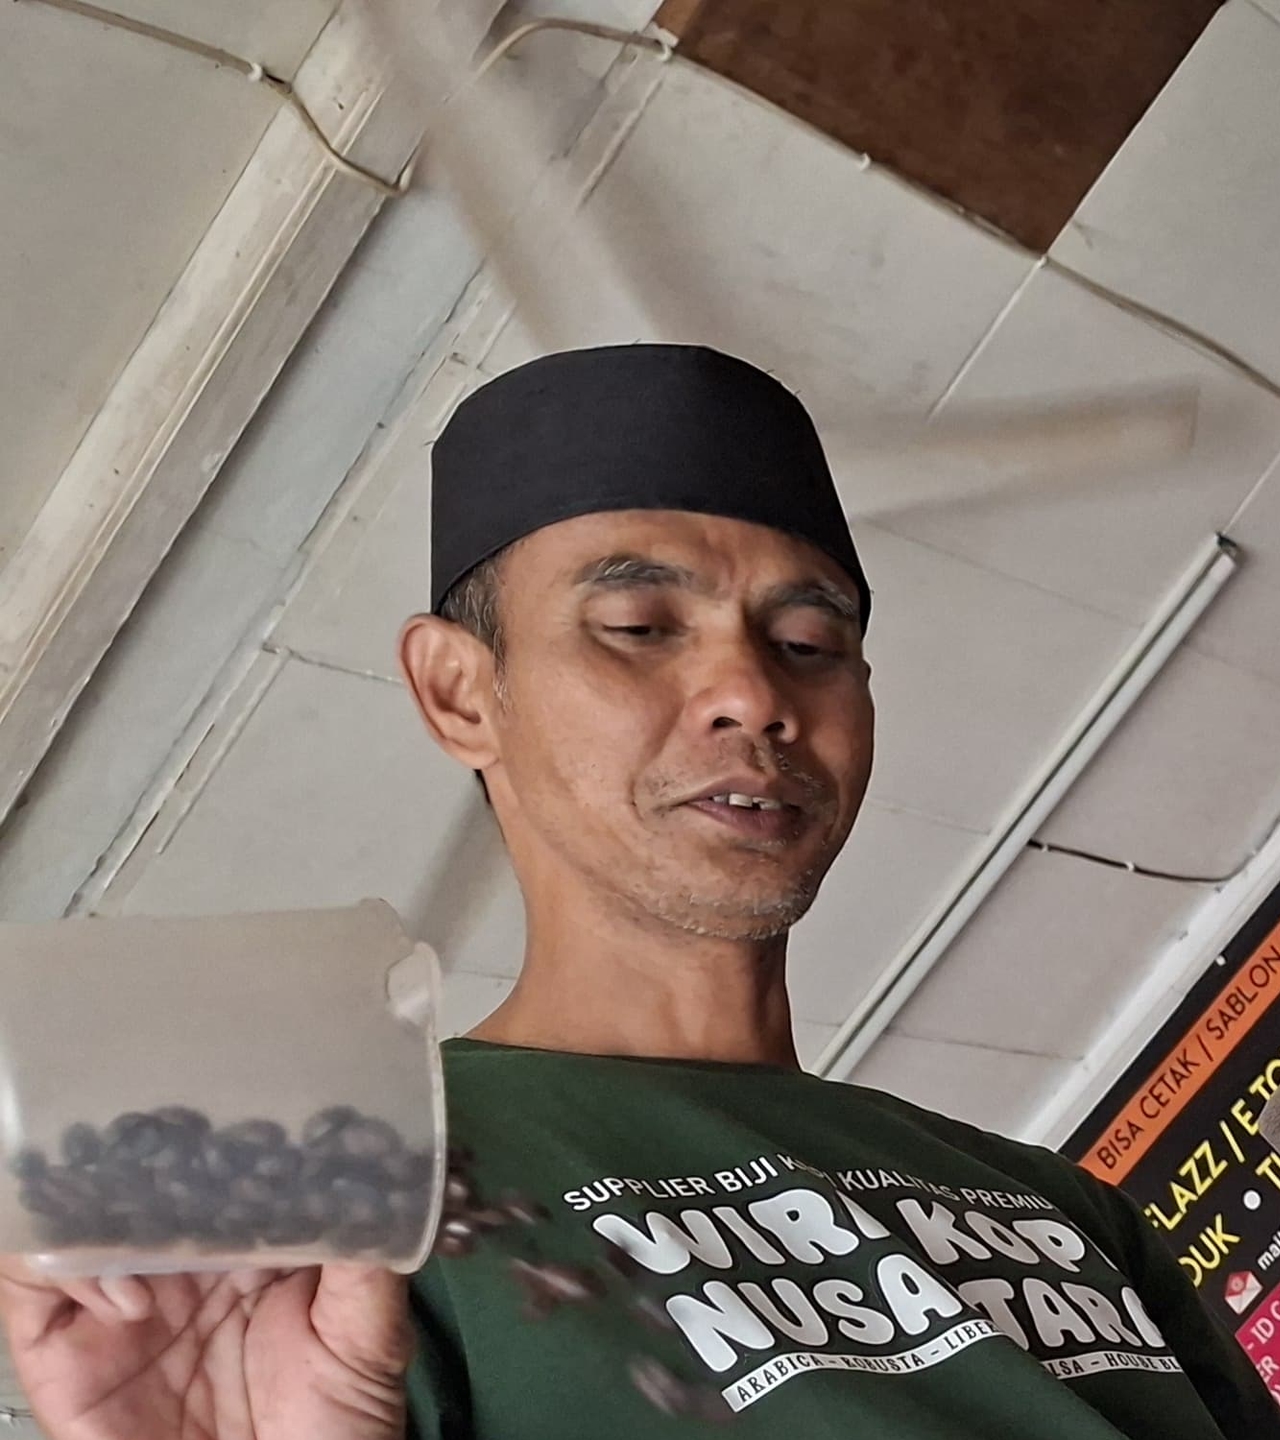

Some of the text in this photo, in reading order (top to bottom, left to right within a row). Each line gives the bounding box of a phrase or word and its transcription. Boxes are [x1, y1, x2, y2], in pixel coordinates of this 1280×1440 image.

[1096, 1120, 1144, 1170] BISA
[1139, 1048, 1200, 1120] CETAK
[1195, 1033, 1214, 1063] /
[564, 1177, 715, 1211] SUPPLIER
[714, 1156, 779, 1192] BIJI
[837, 1168, 961, 1201] KUALITAS
[960, 1187, 1061, 1212] PREMIU
[1144, 1140, 1228, 1230] LAZZ
[896, 1198, 1119, 1272] KOP
[1250, 1317, 1275, 1345] ID
[735, 1354, 822, 1402] ARABICA
[845, 1356, 925, 1372] ROBUSTA
